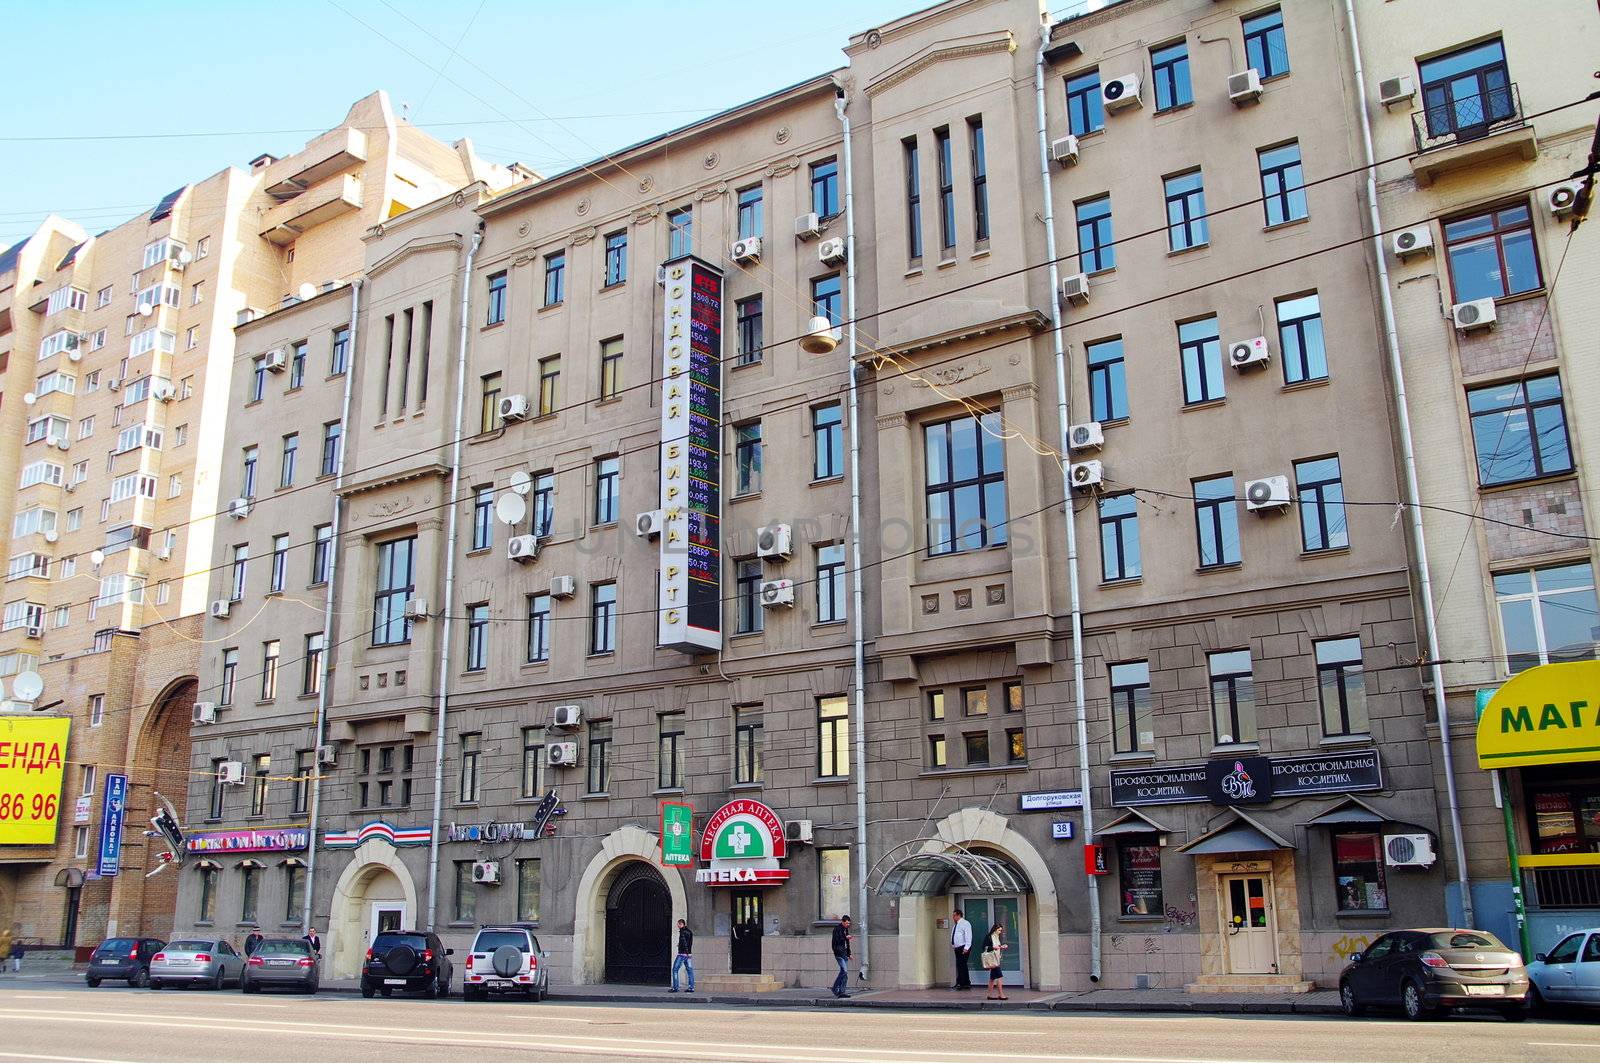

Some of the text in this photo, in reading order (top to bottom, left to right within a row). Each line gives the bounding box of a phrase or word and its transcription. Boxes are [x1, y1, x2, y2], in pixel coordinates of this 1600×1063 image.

[691, 320, 708, 332] GAZP
[689, 480, 708, 491] VTBR
[666, 443, 681, 543] БИРЖА
[688, 559, 708, 571] 50.75
[665, 565, 680, 624] РТС
[1501, 700, 1600, 733] МАГ
[1272, 758, 1374, 776] ПРОФЕССИОНАЛЬНАЯ
[1115, 772, 1207, 786] ПРОФЕССИОНАЛЬНАЯ
[1298, 774, 1351, 786] КОСМЕТИКА
[1026, 793, 1081, 802] Долгоруковская
[1137, 786, 1185, 797] КОСМЕТИКА
[31, 794, 57, 820] 96
[704, 802, 782, 845] ЧЕСТНАЯ АПТЕКА
[1056, 824, 1067, 832] 38
[665, 853, 690, 861] АПТЕКА
